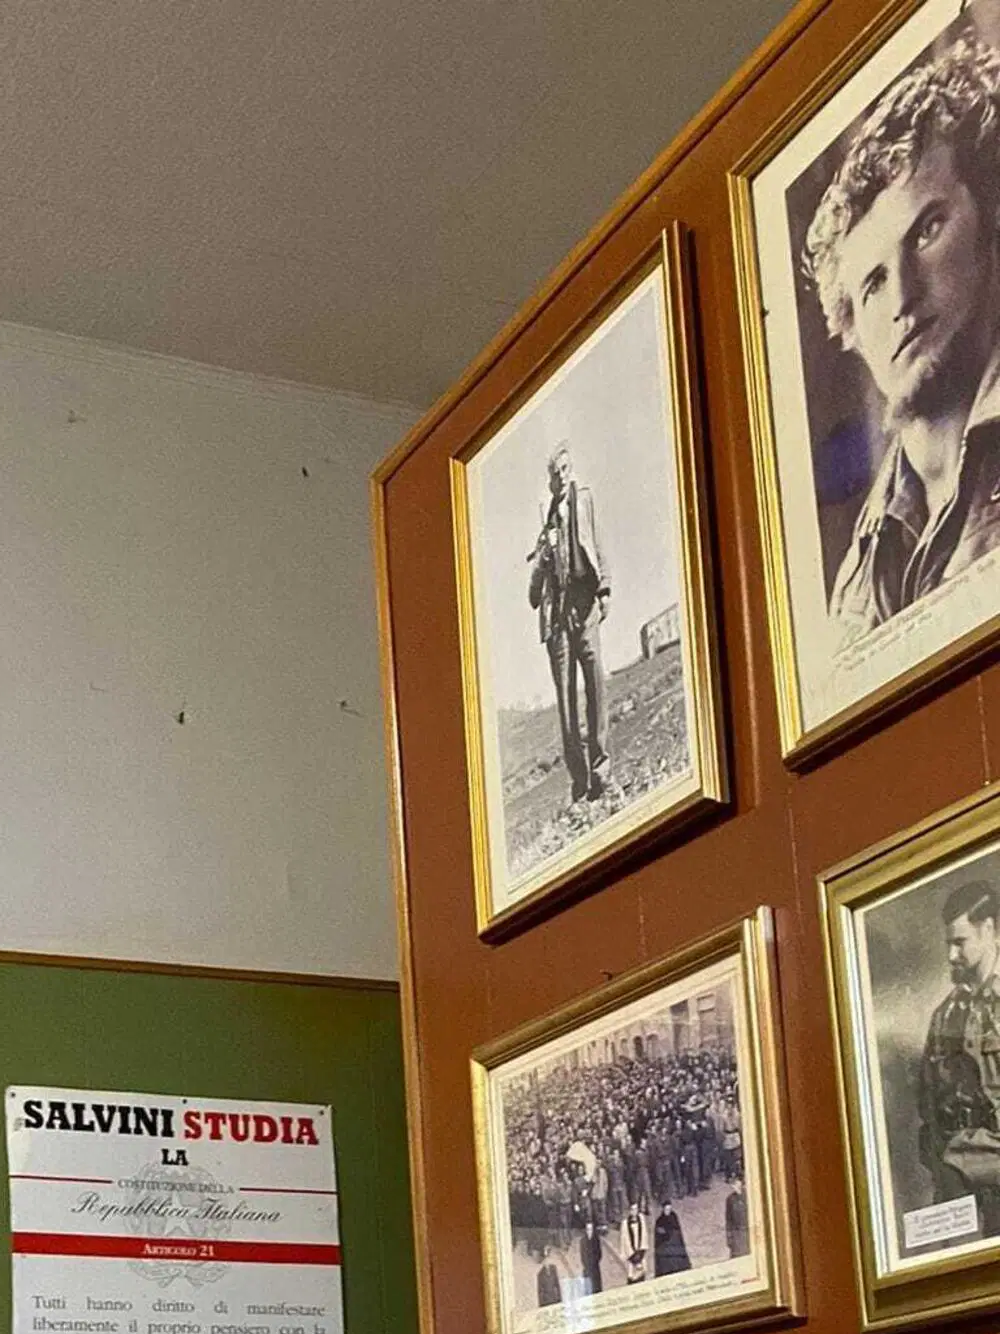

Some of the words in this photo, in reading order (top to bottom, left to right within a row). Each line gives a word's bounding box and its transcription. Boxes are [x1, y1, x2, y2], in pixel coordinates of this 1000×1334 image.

[24, 1099, 174, 1138] SALVINI
[184, 1110, 319, 1145] STUDIA
[161, 1148, 189, 1166] LA
[117, 1178, 195, 1192] COSTITUZIONE
[198, 1182, 235, 1194] DELLA
[70, 1191, 190, 1221] Repubblica
[193, 1197, 282, 1222] Italiana
[200, 1244, 214, 1256] 21
[32, 1296, 66, 1309] Tutti
[86, 1296, 133, 1311] hanno
[152, 1298, 195, 1312] diritto
[214, 1300, 228, 1313] di
[247, 1302, 326, 1316] manifestare
[32, 1317, 119, 1332] liberamente
[128, 1319, 138, 1332] il
